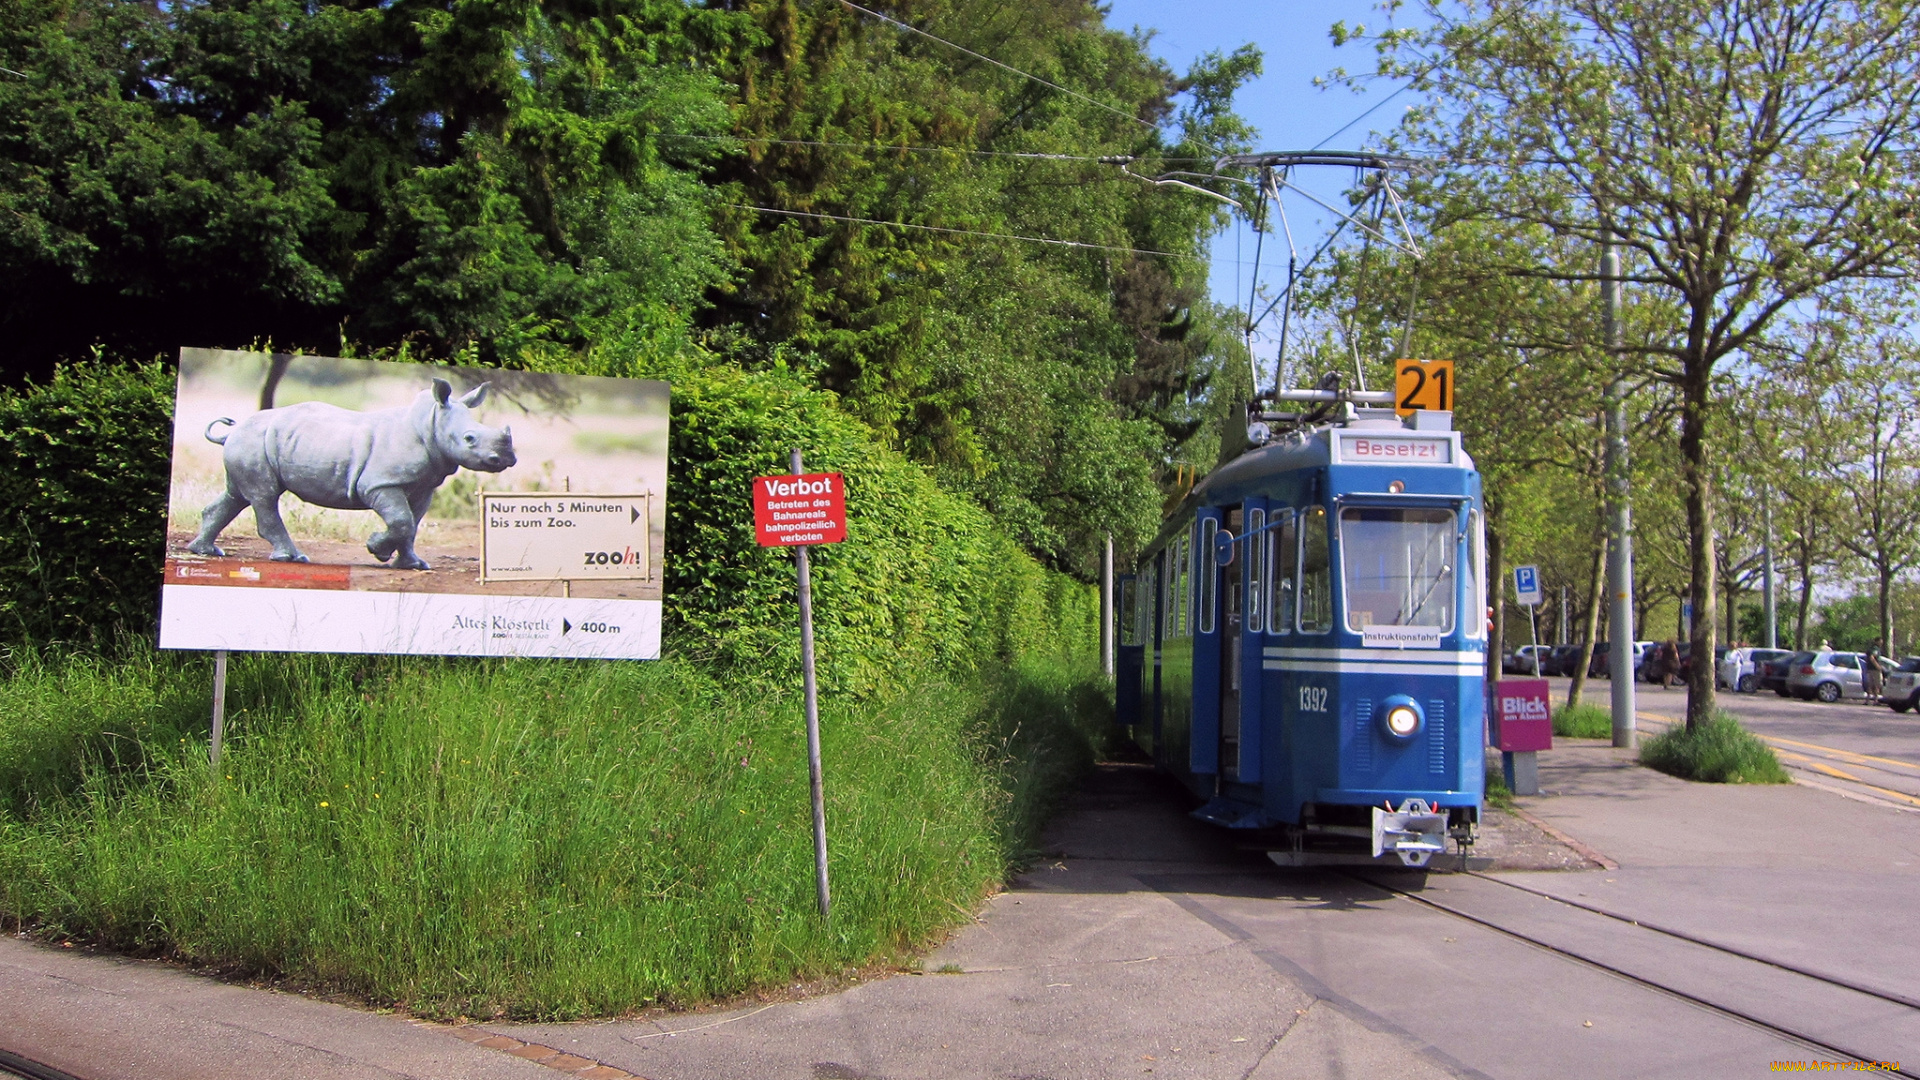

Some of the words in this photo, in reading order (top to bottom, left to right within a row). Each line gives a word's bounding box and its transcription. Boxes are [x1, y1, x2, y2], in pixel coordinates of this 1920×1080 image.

[1401, 365, 1447, 410] 21
[1355, 440, 1437, 457] Besetzt
[765, 478, 831, 496] Verbot
[490, 502, 516, 513] Nur
[521, 502, 552, 513] noch
[556, 502, 565, 513] 5
[570, 502, 623, 513] Minuten
[767, 500, 809, 510] Betreten
[813, 499, 831, 507] des
[490, 518, 509, 528] bis
[514, 519, 542, 528] zum
[547, 517, 576, 528] Zoo.
[773, 510, 826, 521] Bahnareals
[765, 520, 836, 532] bahnpolizeilich
[780, 533, 823, 542] verboten
[584, 546, 640, 565] zooh!
[1521, 569, 1531, 584] P
[452, 615, 487, 630] Altes
[580, 622, 607, 633] 400
[608, 625, 621, 633] m
[1364, 632, 1439, 642] Instruktionsfahrt
[1299, 686, 1328, 713] 1392
[1502, 696, 1547, 714] Blick
